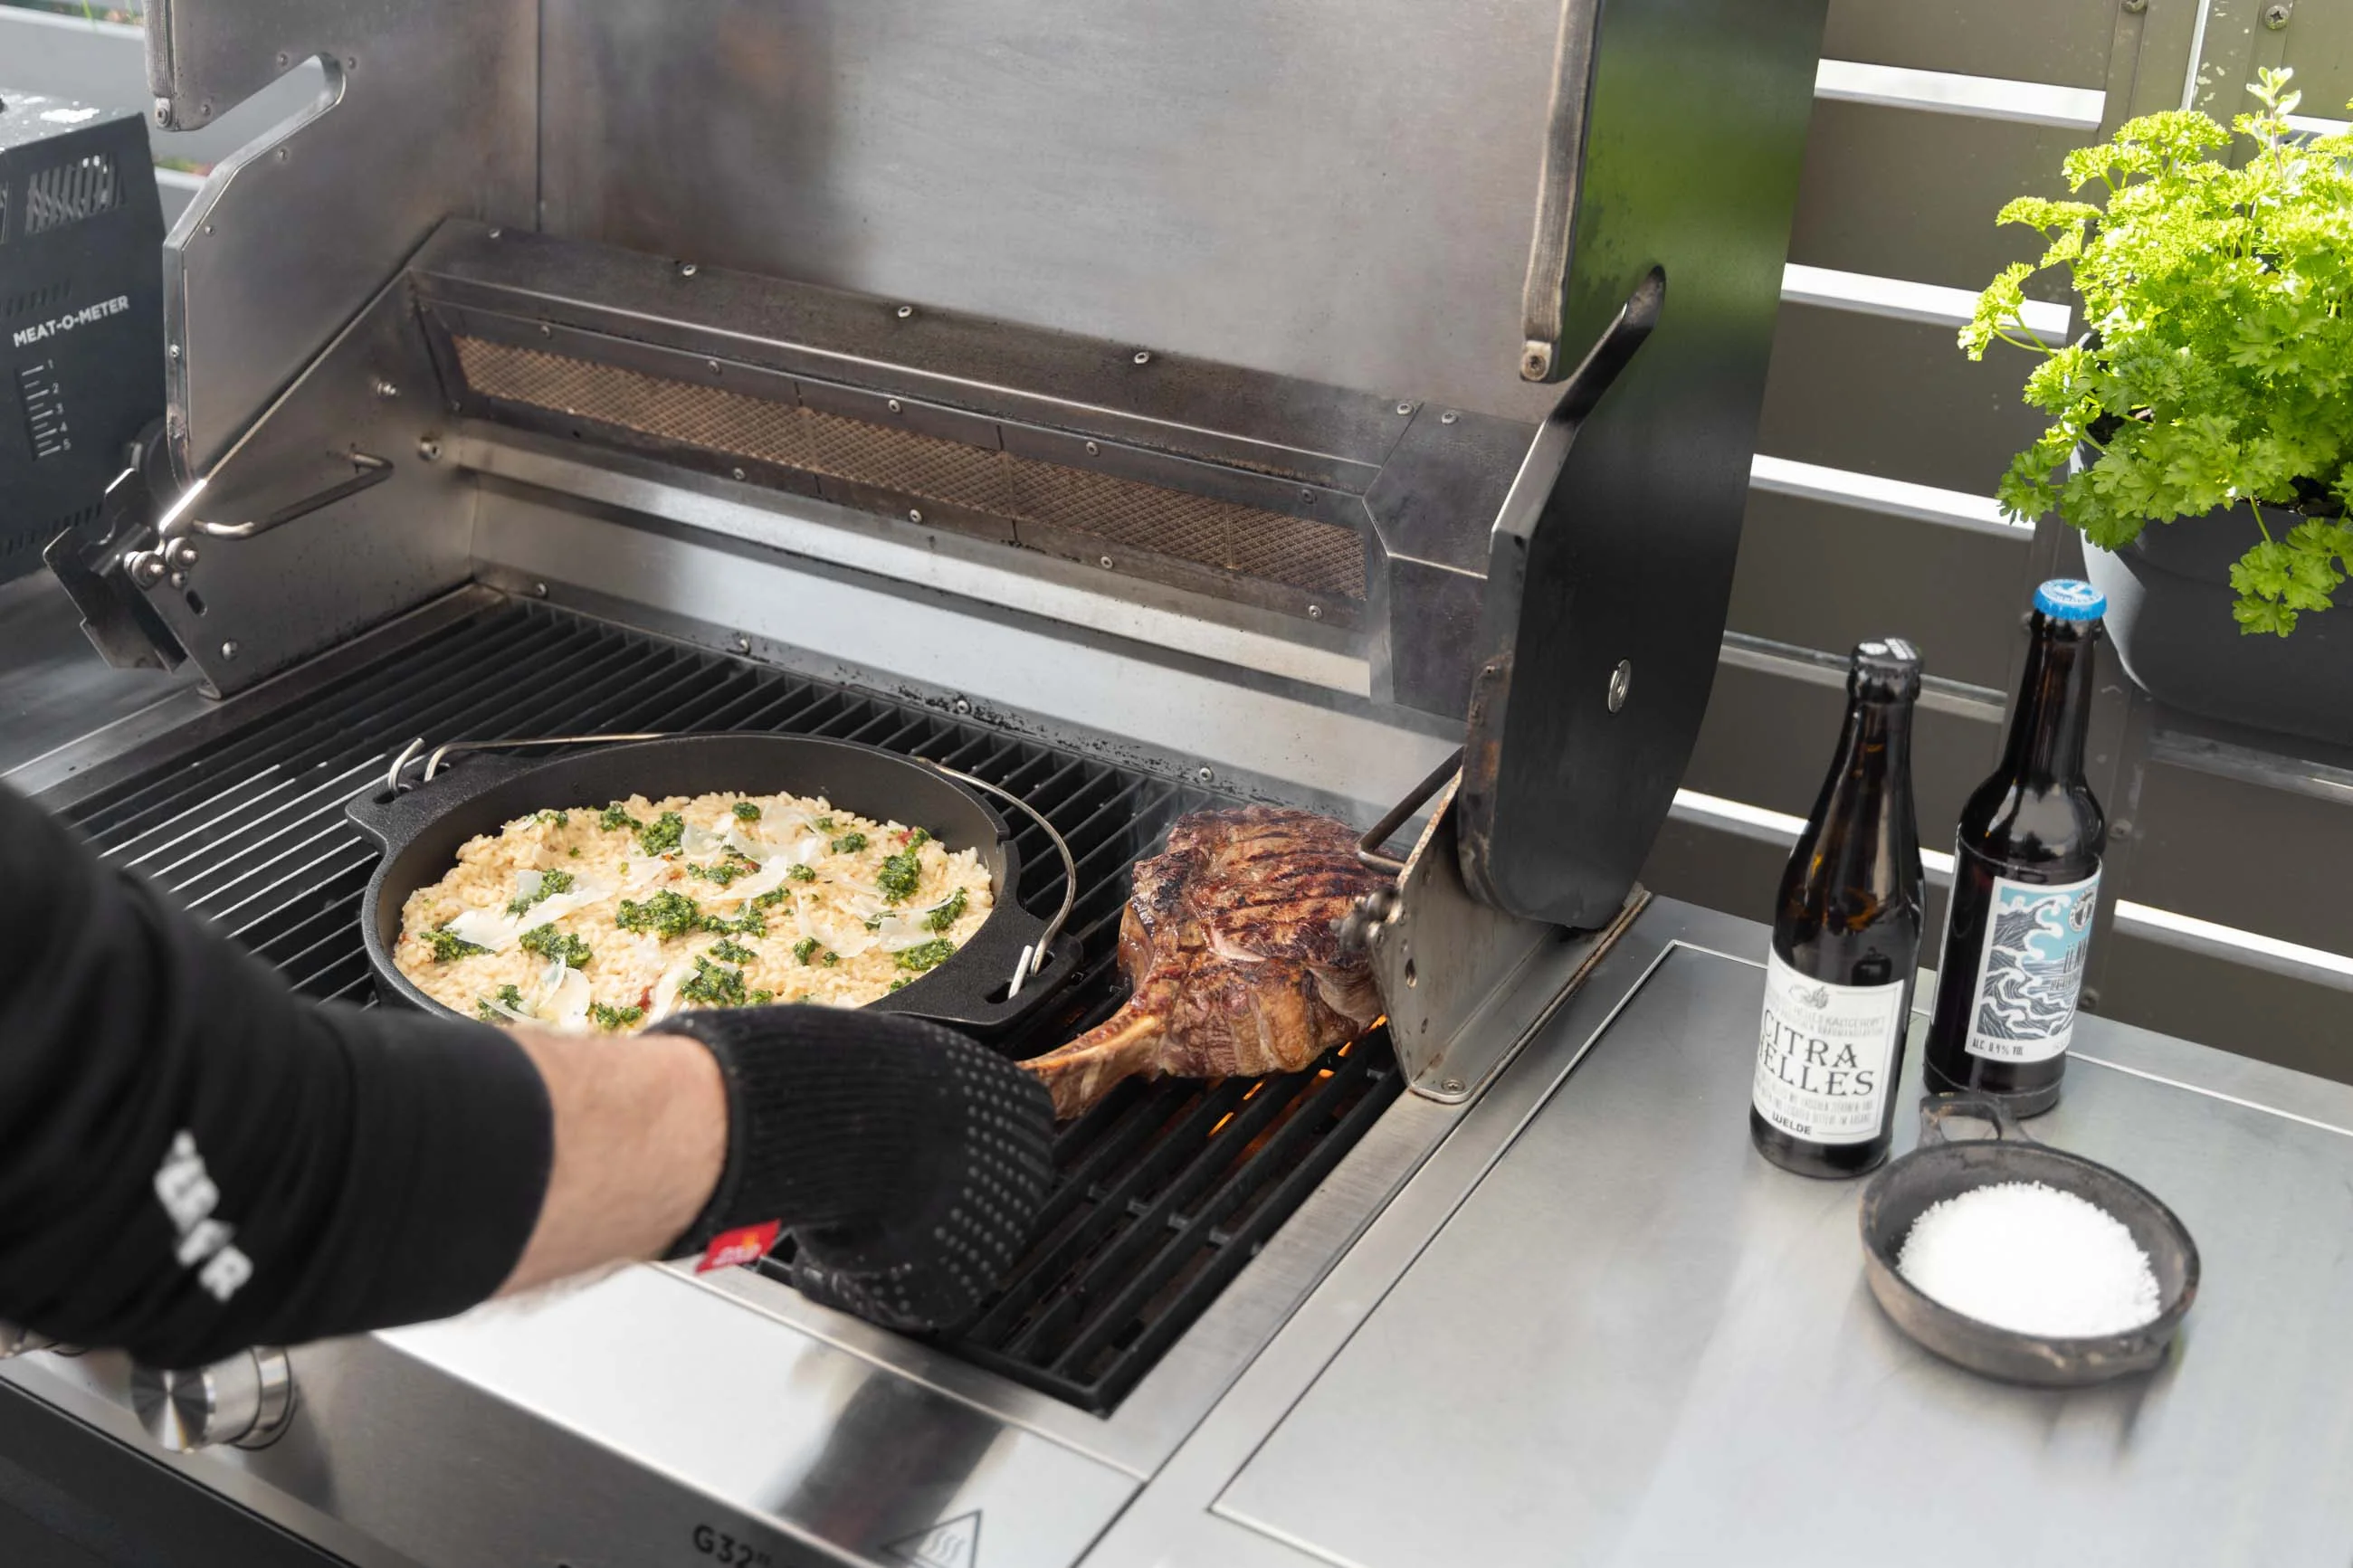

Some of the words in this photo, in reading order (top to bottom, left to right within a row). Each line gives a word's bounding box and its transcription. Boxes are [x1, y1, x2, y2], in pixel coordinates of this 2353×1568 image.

[13, 295, 129, 348] MEAT-O-METER
[47, 359, 54, 369] 1
[52, 383, 60, 394] 2
[56, 403, 64, 415] 3
[59, 421, 69, 432] 4
[62, 438, 71, 451] 5
[1764, 1008, 1859, 1069] CITRA
[1771, 1111, 1812, 1136] WELDE
